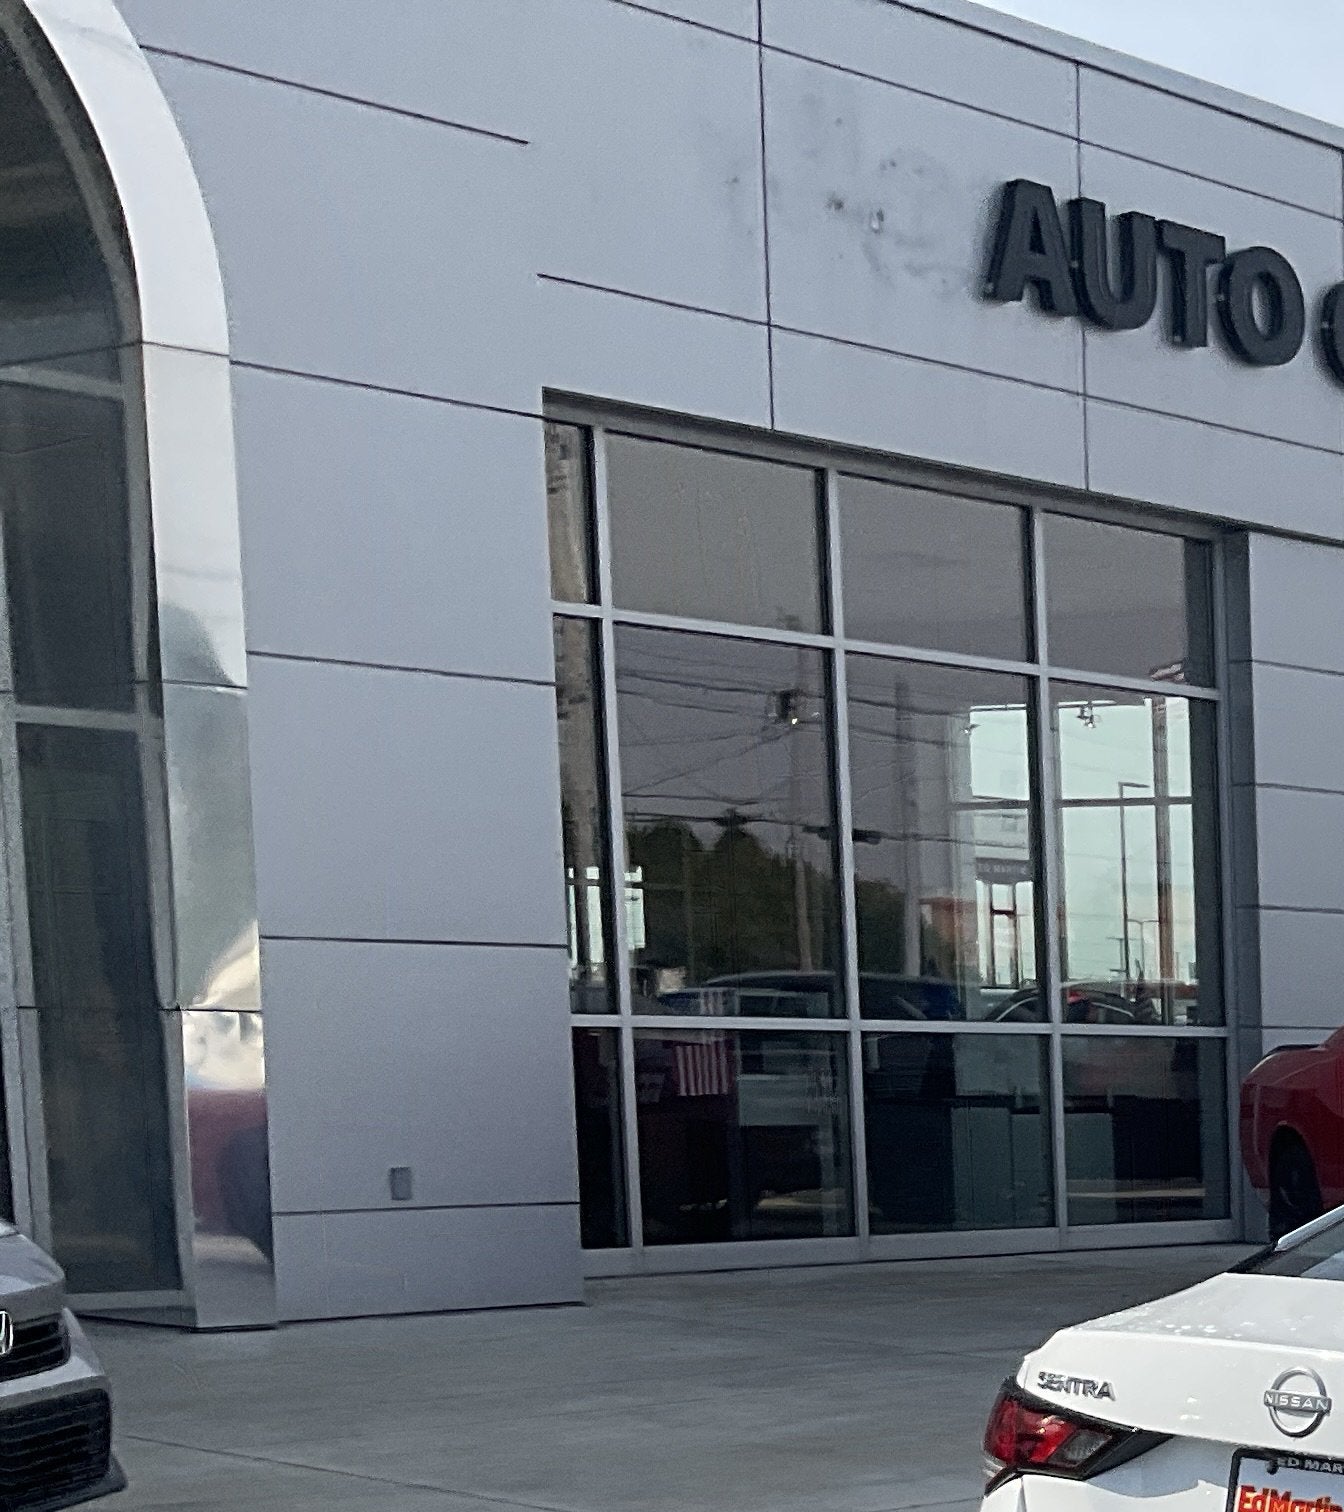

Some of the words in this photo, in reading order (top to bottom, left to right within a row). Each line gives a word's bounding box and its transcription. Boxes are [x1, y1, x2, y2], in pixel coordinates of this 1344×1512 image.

[984, 178, 1305, 367] AUTO
[1038, 1371, 1116, 1401] SENTRA
[1264, 1390, 1329, 1411] NISSAN
[1277, 1457, 1300, 1467] ED
